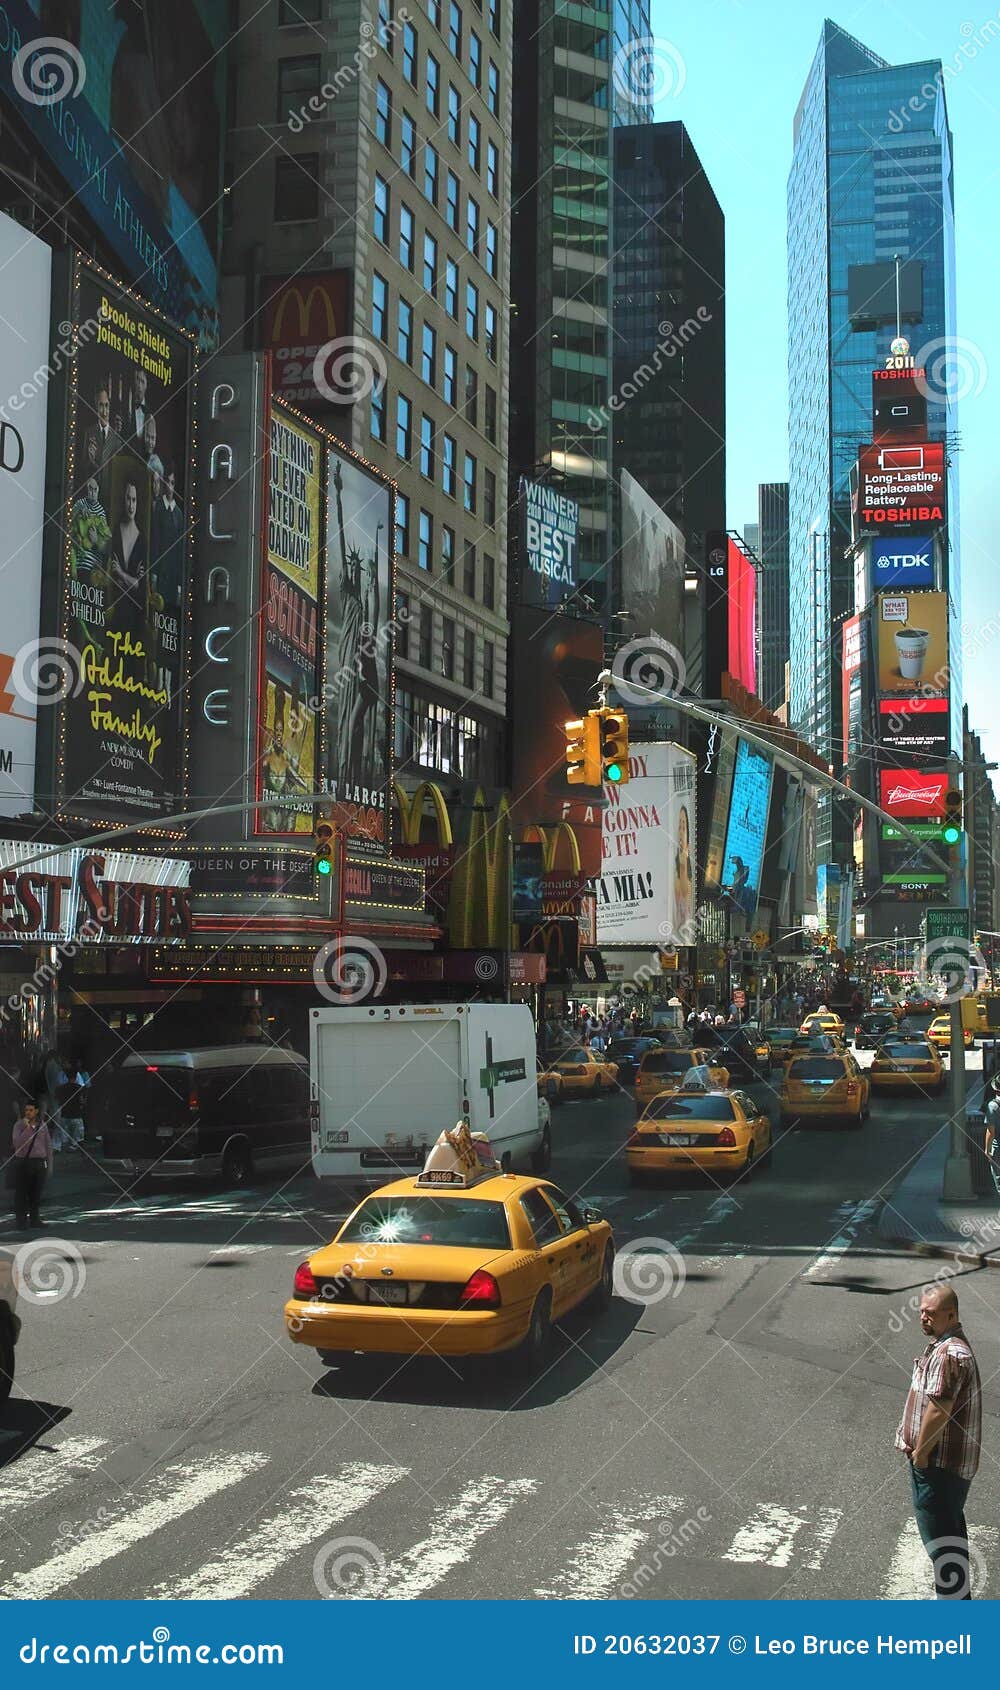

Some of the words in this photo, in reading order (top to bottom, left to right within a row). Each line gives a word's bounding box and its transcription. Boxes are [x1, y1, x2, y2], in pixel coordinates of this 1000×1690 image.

[113, 184, 169, 292] ATHLETES
[102, 296, 136, 337] Brooke
[138, 322, 170, 359] Shields
[97, 319, 121, 352] joins
[123, 338, 139, 363] the
[140, 348, 172, 386] family!
[886, 356, 914, 369] 2011
[872, 368, 926, 380] TOSHIBA
[271, 418, 314, 477] RYTHING
[282, 461, 306, 502] EVER
[865, 472, 942, 484] Long-Lasting,
[865, 483, 934, 495] Replaceable
[525, 479, 578, 522] WINNER!
[865, 496, 907, 506] Battery
[297, 503, 311, 539] ON
[862, 506, 943, 522] TOSHIBA
[203, 384, 235, 724] PALACE
[527, 517, 576, 567] BEST
[527, 550, 576, 587] MUSICAL
[710, 567, 723, 576] LG
[889, 554, 930, 568] TDK
[71, 580, 104, 607] BROOKE
[71, 601, 105, 627] SHIELDS
[154, 611, 178, 636] ROGER
[268, 572, 316, 657] SCILLA
[106, 630, 145, 657] The
[267, 630, 276, 644] OF
[279, 638, 290, 658] THE
[292, 649, 315, 672] DESERT
[80, 645, 168, 704] Addams
[88, 691, 161, 764] Family
[100, 741, 107, 751] A
[110, 756, 135, 771] COMEDY
[345, 784, 385, 809] LARGE
[888, 789, 940, 801] Budweiser
[604, 804, 661, 832] GONNA
[601, 836, 612, 858] E
[616, 832, 638, 857] IT!
[190, 859, 234, 872] QUEEN
[239, 860, 259, 870] OF
[263, 860, 287, 871] THE
[289, 861, 312, 873] DESERT
[371, 873, 387, 884] QUEEN
[394, 875, 402, 886] THE
[612, 872, 653, 902] MIA!
[78, 855, 192, 939] SUITES
[929, 912, 967, 923] SOUTHBOUND
[932, 926, 943, 936] USE
[953, 926, 964, 936] AVE
